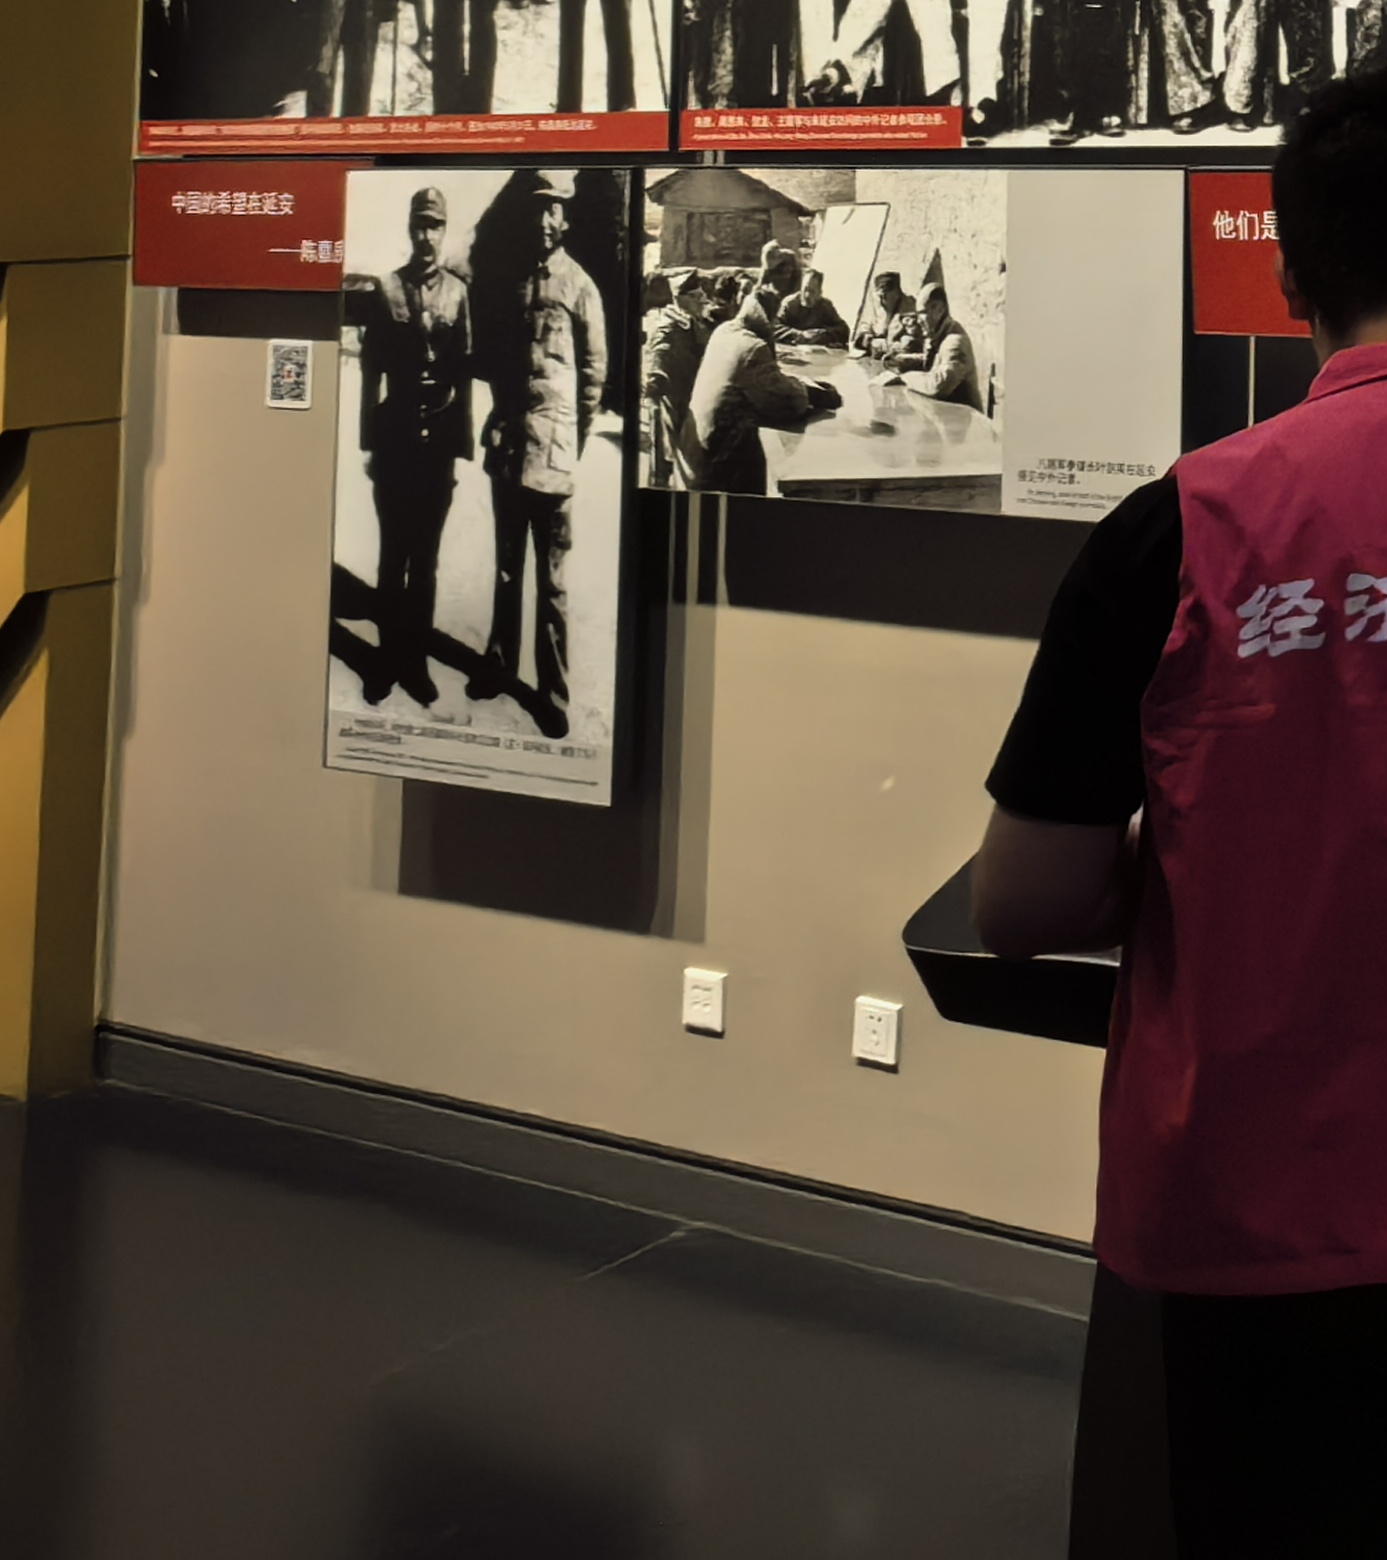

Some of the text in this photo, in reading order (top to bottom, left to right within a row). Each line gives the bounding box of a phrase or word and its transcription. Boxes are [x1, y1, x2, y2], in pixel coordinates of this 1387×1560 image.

[171, 191, 295, 215] 中国的希望在延安
